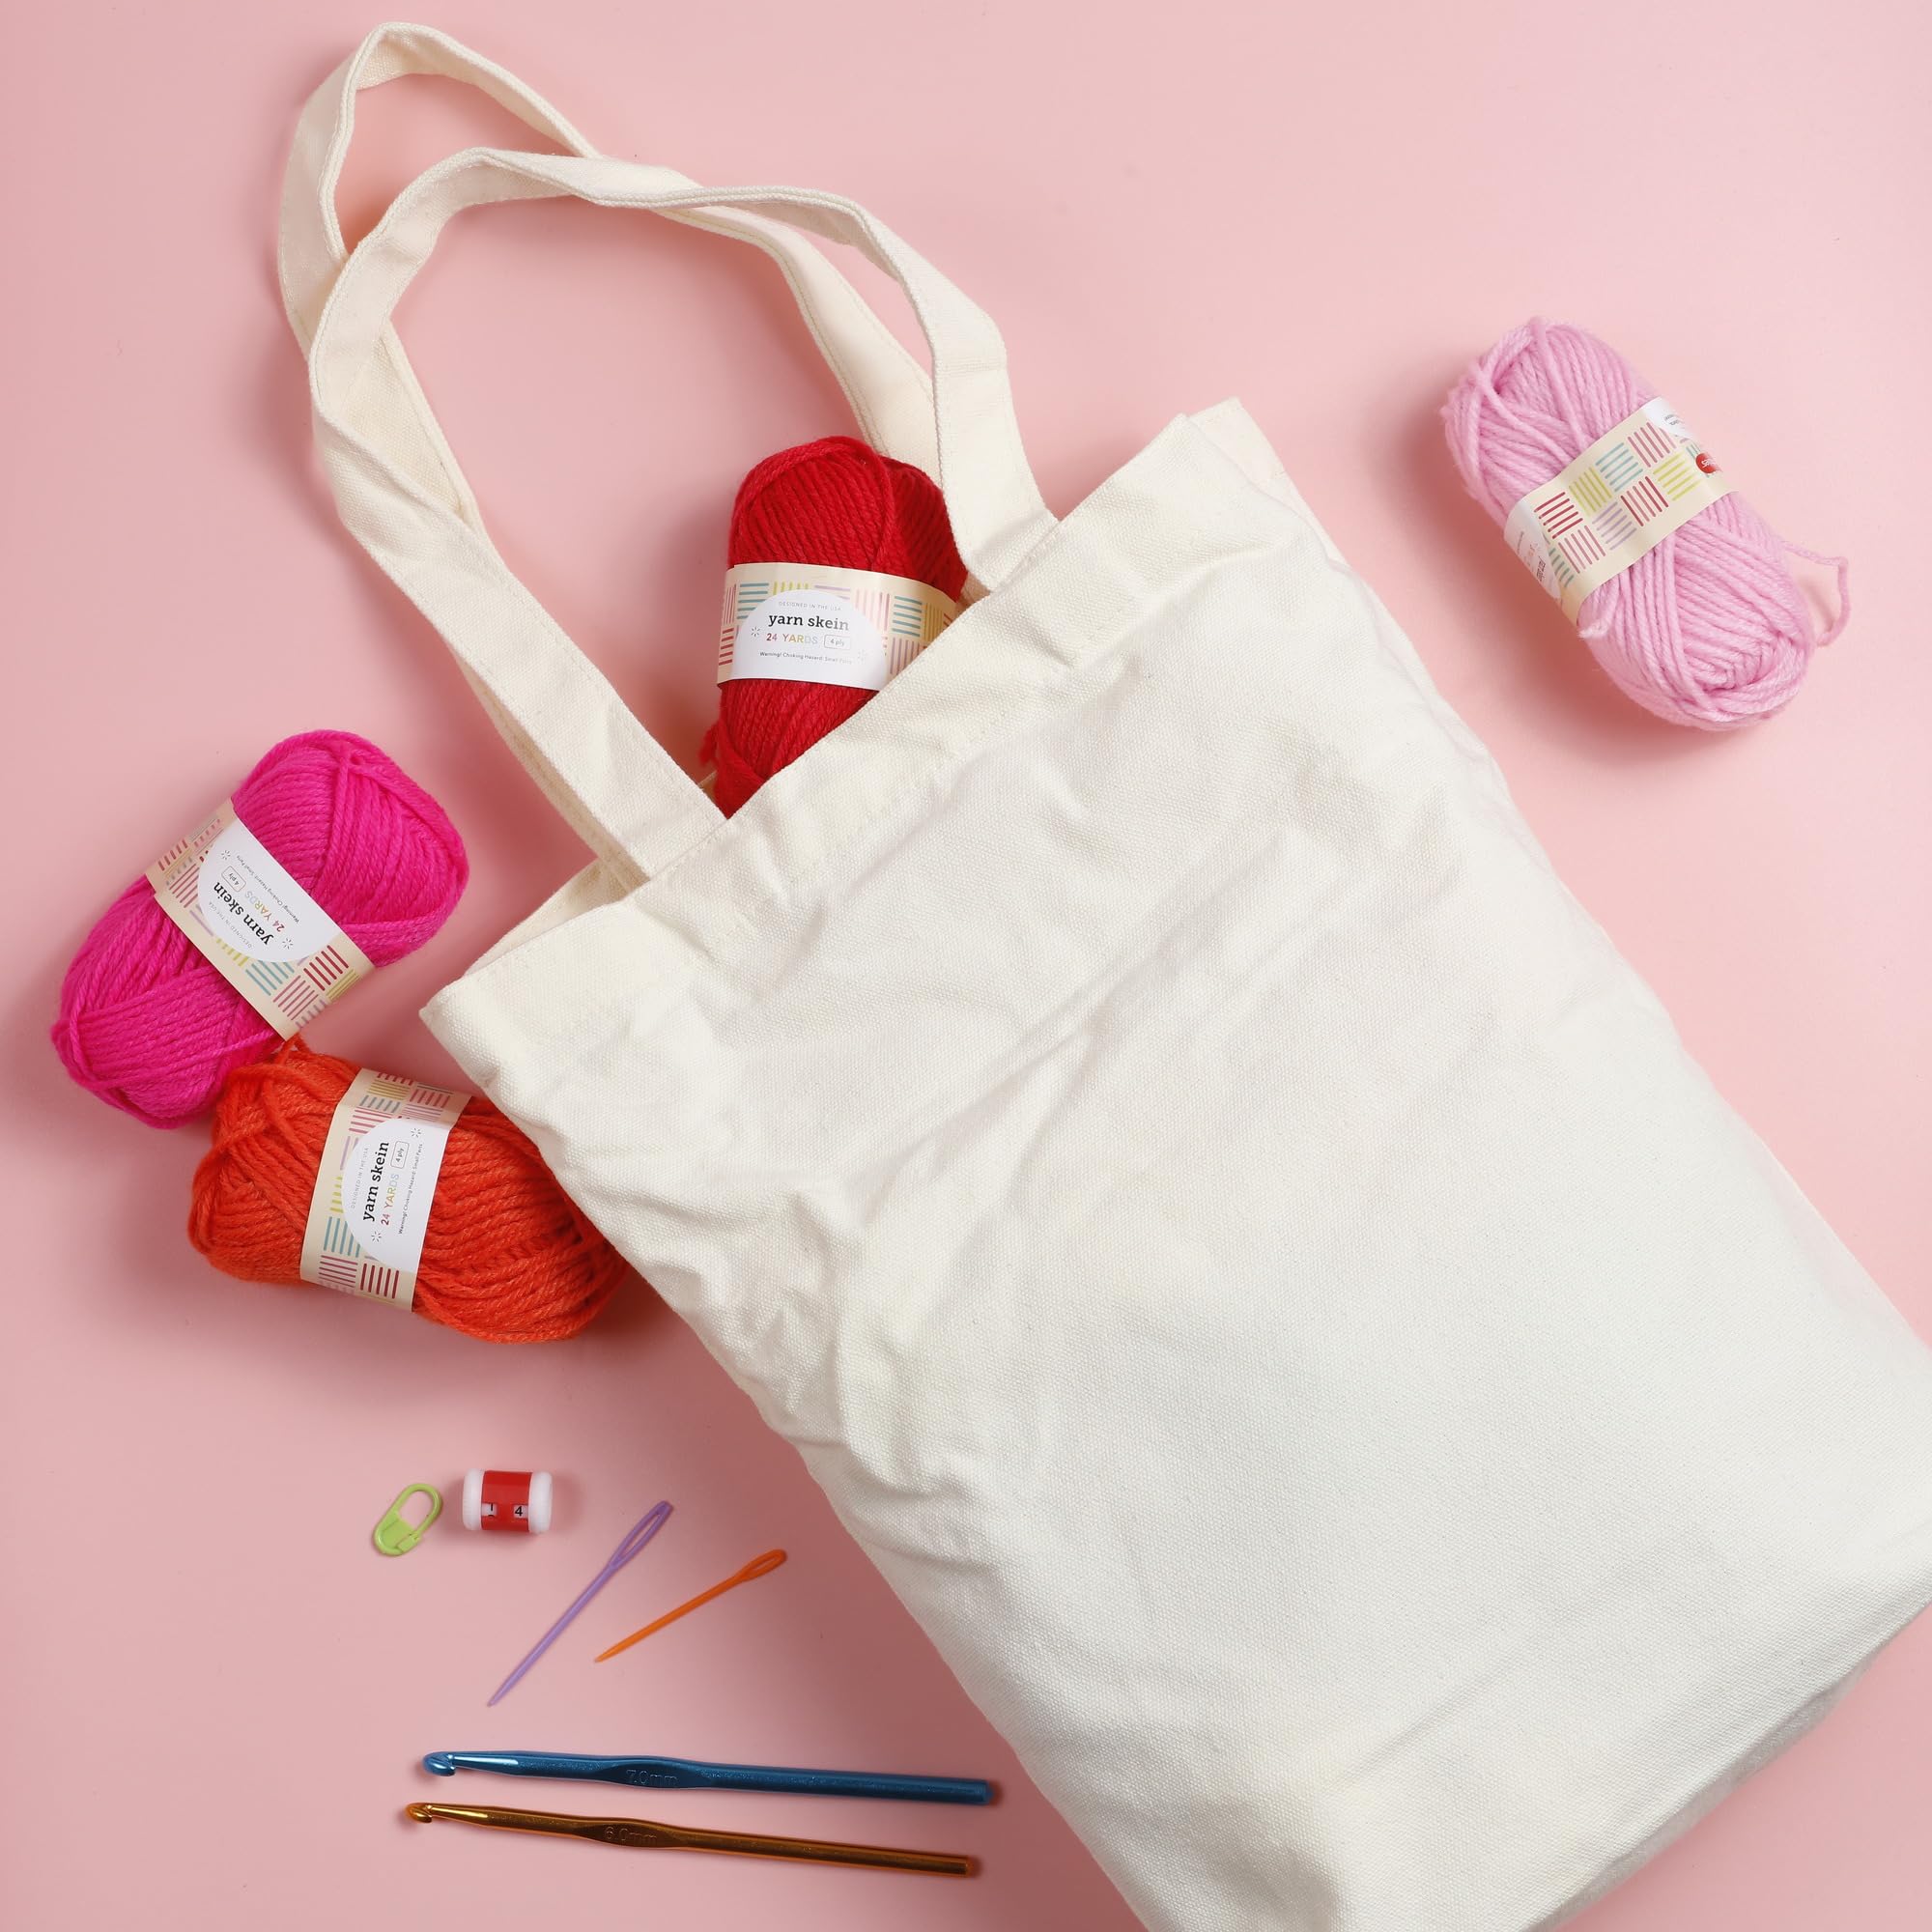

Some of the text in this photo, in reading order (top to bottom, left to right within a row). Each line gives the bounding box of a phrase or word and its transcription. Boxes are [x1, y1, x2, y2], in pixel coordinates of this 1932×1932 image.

[768, 615, 849, 631] yarn skein
[766, 633, 818, 644] 24 YARDS
[835, 639, 844, 647] ply
[229, 872, 238, 881] ply
[213, 882, 274, 945] yarn skein
[244, 891, 285, 932] 24 YARDS
[282, 905, 299, 923] Warning!
[363, 1142, 389, 1222] yarn skein
[381, 1174, 399, 1225] 24 YARDS
[398, 1211, 408, 1235] Warning!
[515, 1506, 523, 1517] 4
[626, 1769, 679, 1786] 7.0mm
[605, 1826, 658, 1844] 6.0mm
